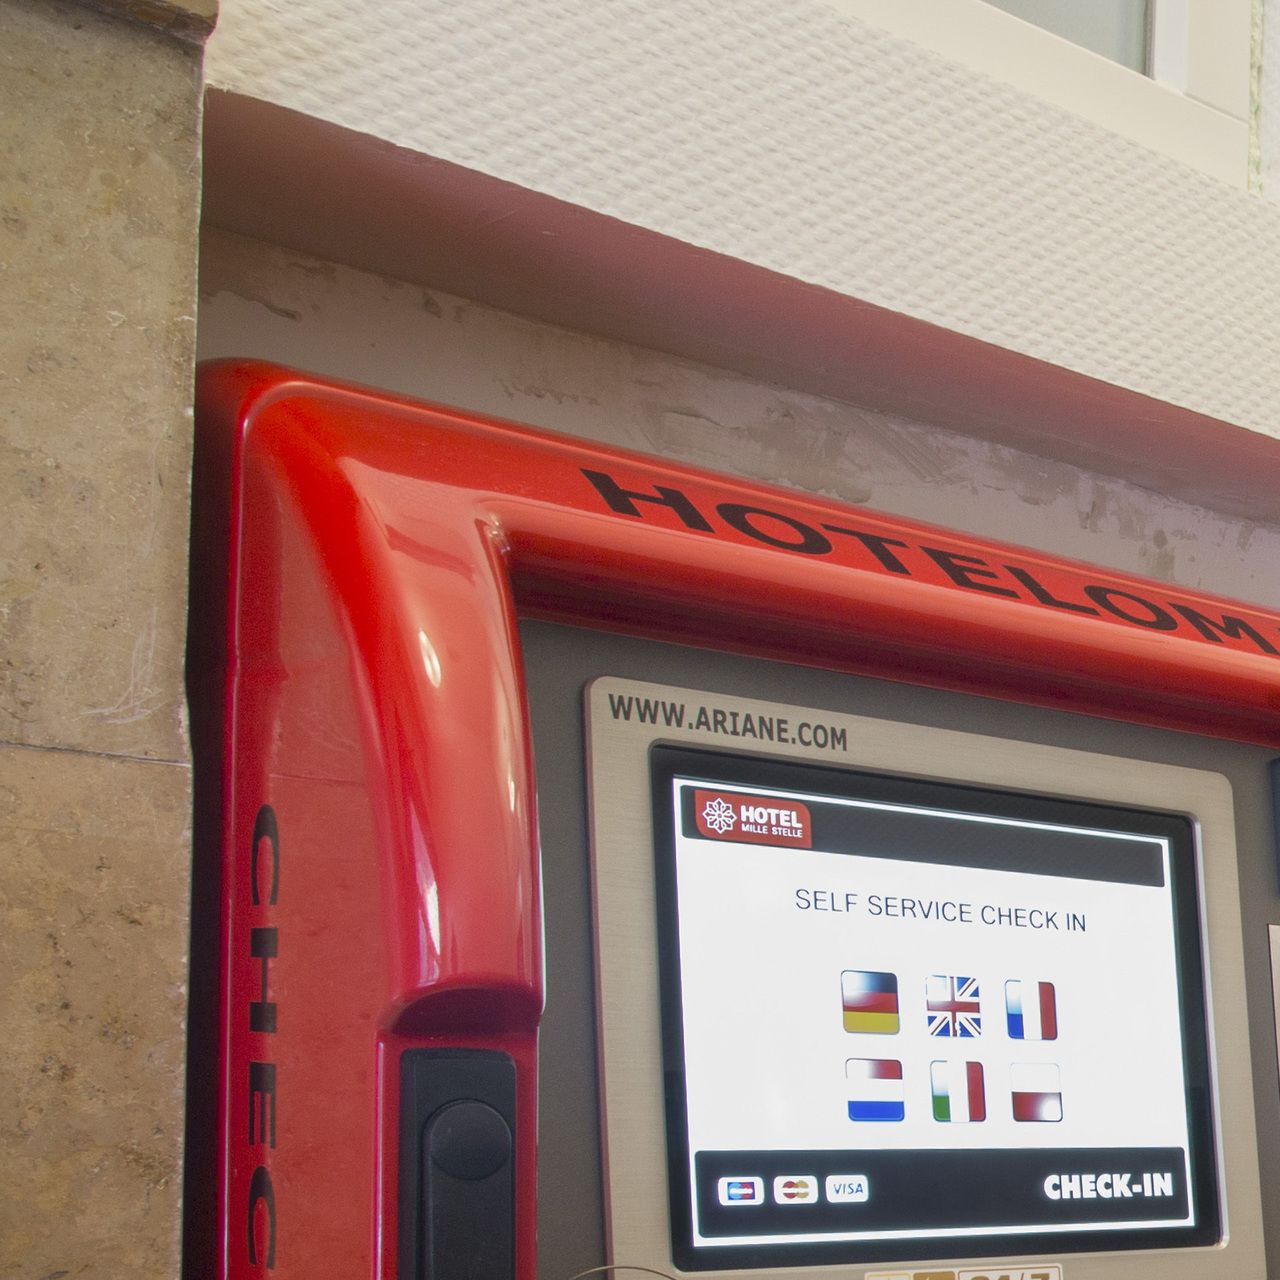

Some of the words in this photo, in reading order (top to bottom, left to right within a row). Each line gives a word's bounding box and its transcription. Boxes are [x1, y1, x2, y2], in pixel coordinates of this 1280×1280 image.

[608, 693, 848, 751] WWW.ARIANE.COM
[740, 805, 803, 828] HOTEL
[741, 823, 769, 834] MILLE
[771, 826, 803, 838] STELLE
[795, 889, 859, 912] SELF
[867, 895, 973, 923] SERVICE
[981, 905, 1059, 930] CHECK
[1066, 913, 1086, 932] IN
[833, 1183, 864, 1195] VISA
[1043, 1173, 1173, 1200] CHECK-IN
